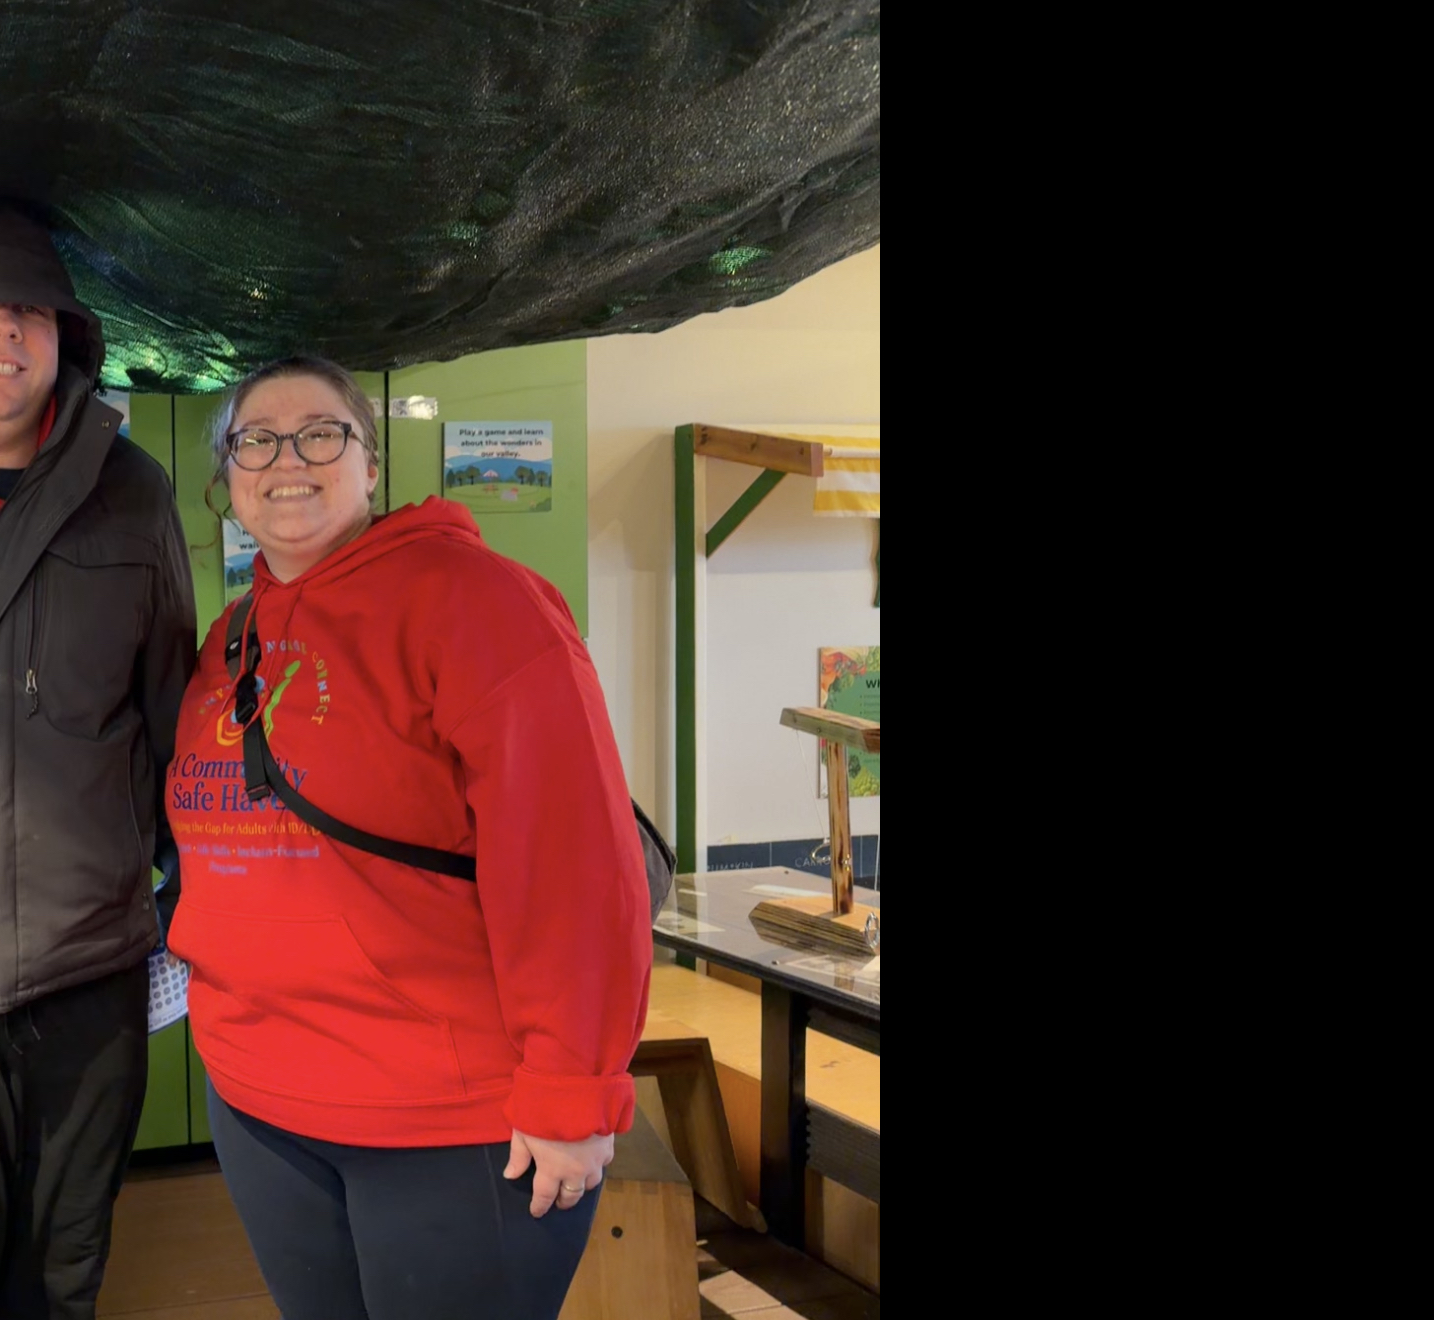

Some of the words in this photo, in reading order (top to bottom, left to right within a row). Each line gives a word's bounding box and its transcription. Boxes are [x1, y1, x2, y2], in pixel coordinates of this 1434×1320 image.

[459, 429, 475, 437] Play
[484, 429, 506, 437] game
[496, 450, 521, 458] valley.
[312, 651, 330, 725] CONNECT
[181, 753, 308, 793] Commity
[173, 781, 214, 813] Safe
[220, 783, 291, 813] Have
[192, 821, 204, 833] the
[205, 821, 221, 836] Gap
[222, 822, 235, 834] for
[237, 822, 267, 835] Adults
